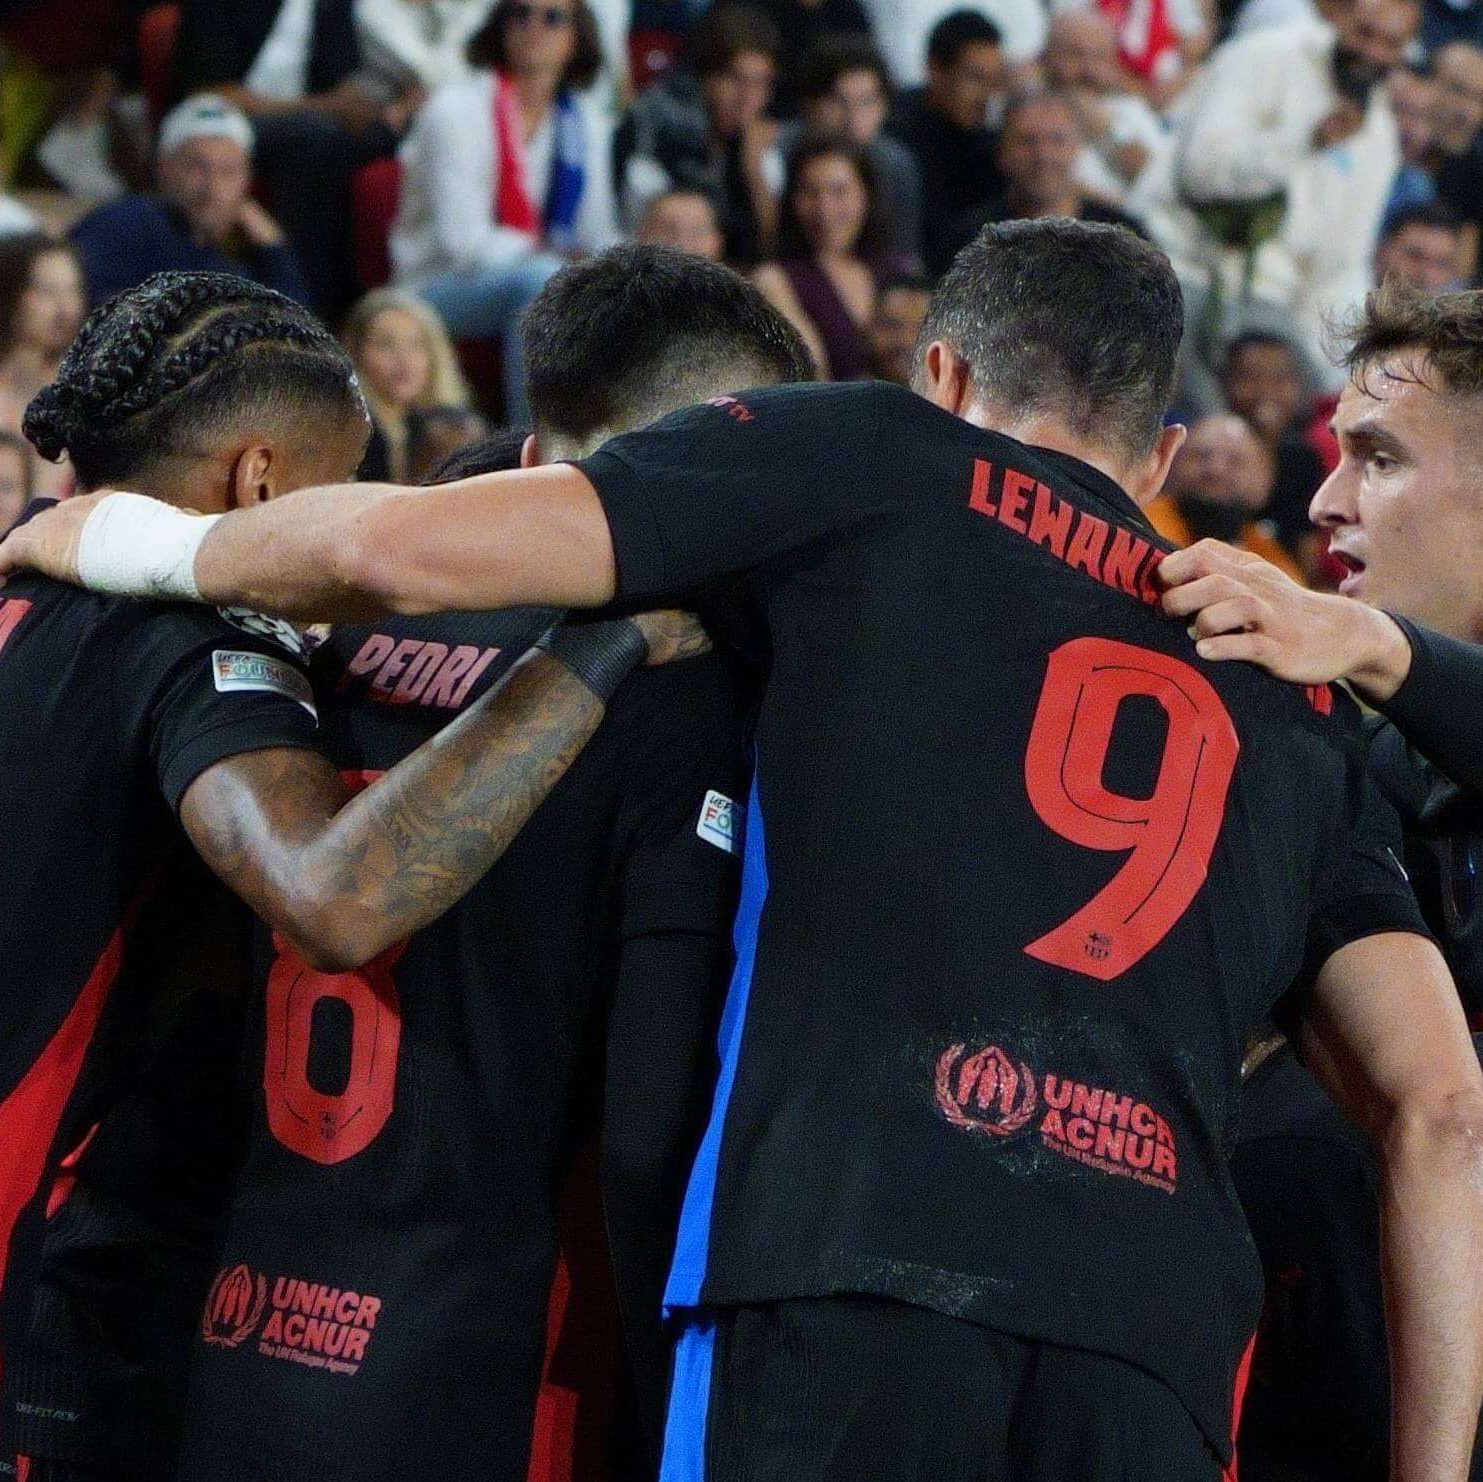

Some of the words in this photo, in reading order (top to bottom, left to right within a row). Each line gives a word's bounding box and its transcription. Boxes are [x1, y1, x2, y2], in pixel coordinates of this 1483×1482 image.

[338, 633, 501, 710] PEDRI
[1022, 636, 1240, 981] 9
[263, 768, 408, 1165] 6
[1041, 1109, 1177, 1181] ACNUR
[1042, 1073, 1174, 1151] UNHCR
[260, 1309, 371, 1361] ACNUR
[271, 1277, 383, 1330] UNHCR
